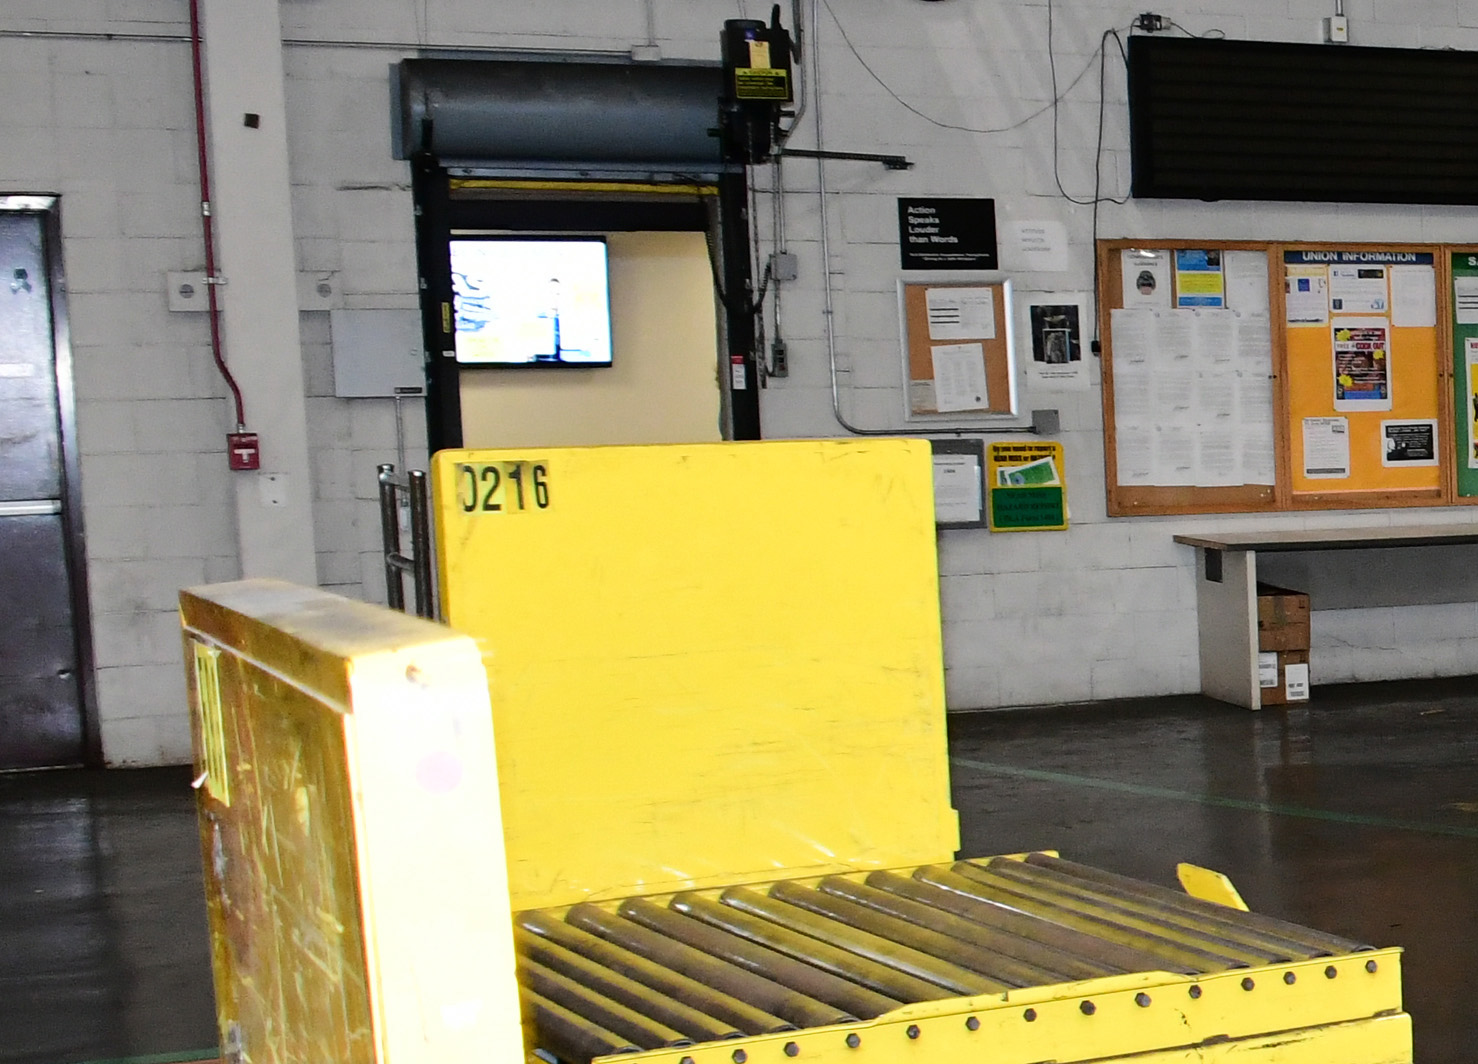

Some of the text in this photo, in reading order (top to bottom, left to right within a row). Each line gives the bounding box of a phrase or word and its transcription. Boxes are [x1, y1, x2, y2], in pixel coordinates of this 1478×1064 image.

[908, 206, 936, 214] Action
[908, 216, 940, 224] Speaks
[908, 226, 940, 234] Louder
[931, 235, 959, 243] Words
[1302, 251, 1416, 262] UNION INFORMATION
